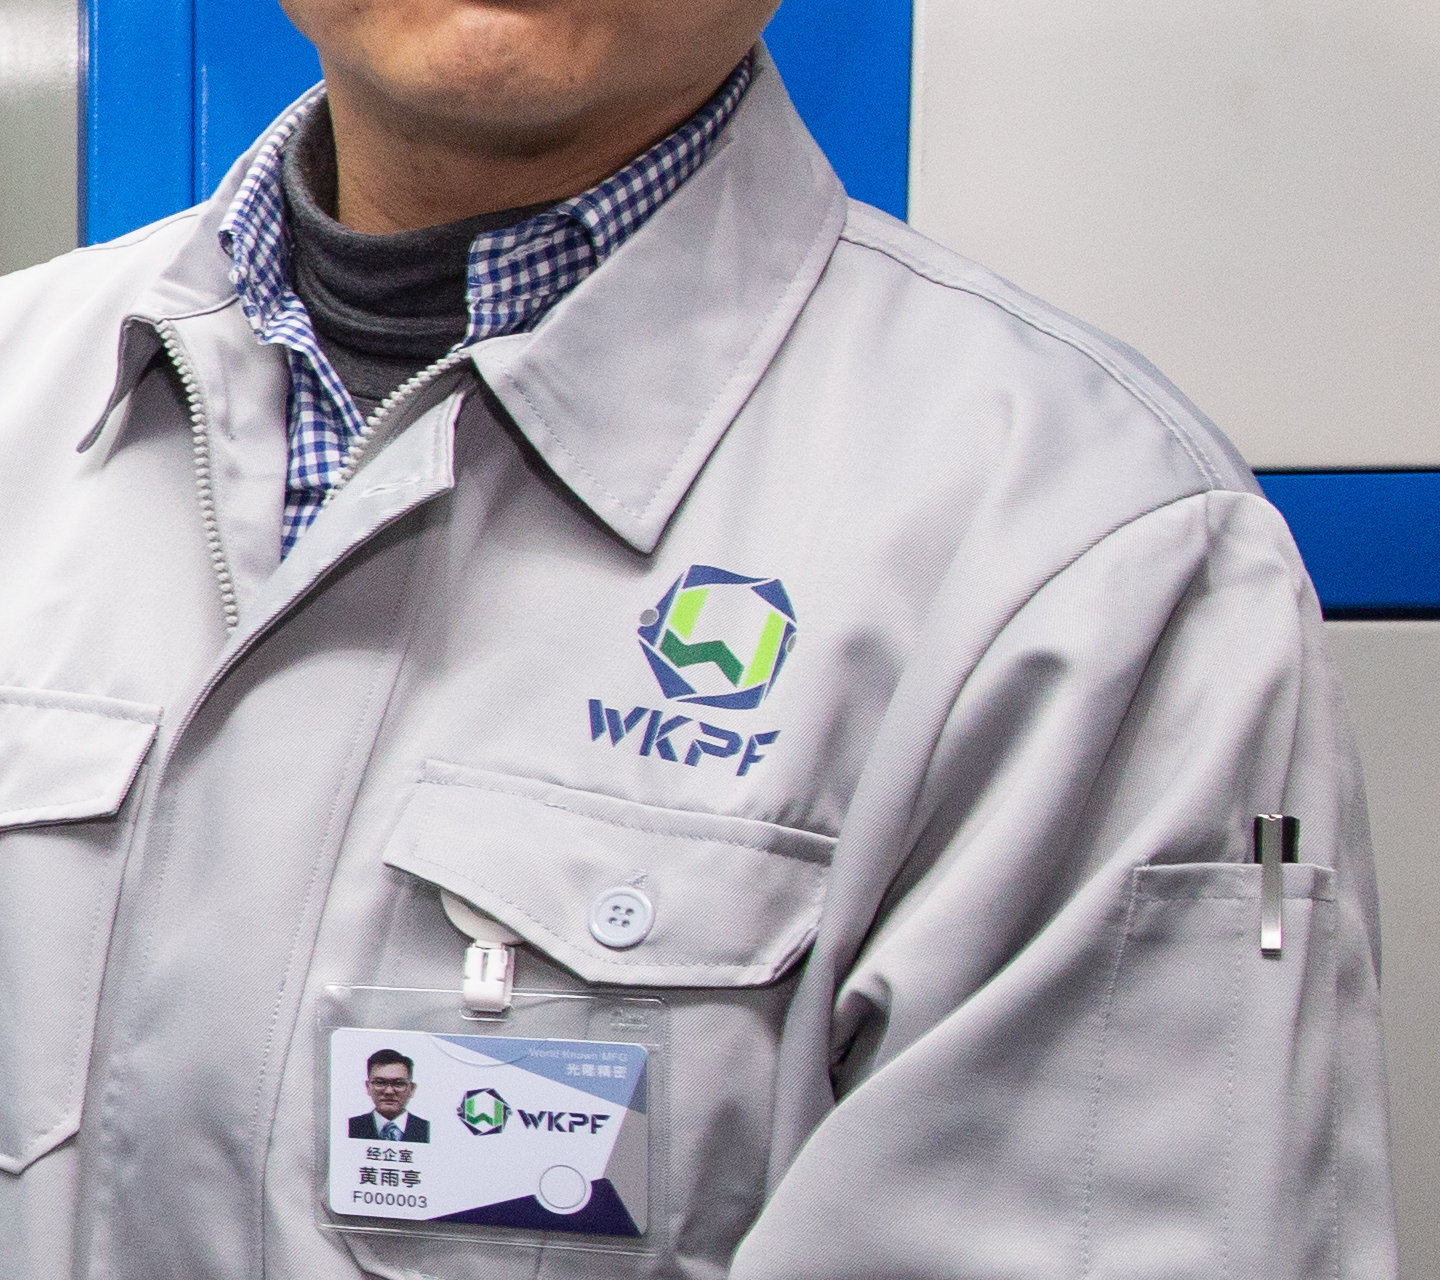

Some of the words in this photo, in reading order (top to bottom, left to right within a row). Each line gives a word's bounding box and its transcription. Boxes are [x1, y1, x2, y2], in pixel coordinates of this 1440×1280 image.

[588, 698, 781, 776] WKPF
[517, 1109, 611, 1134] WKPF
[353, 1190, 428, 1208] F000003
